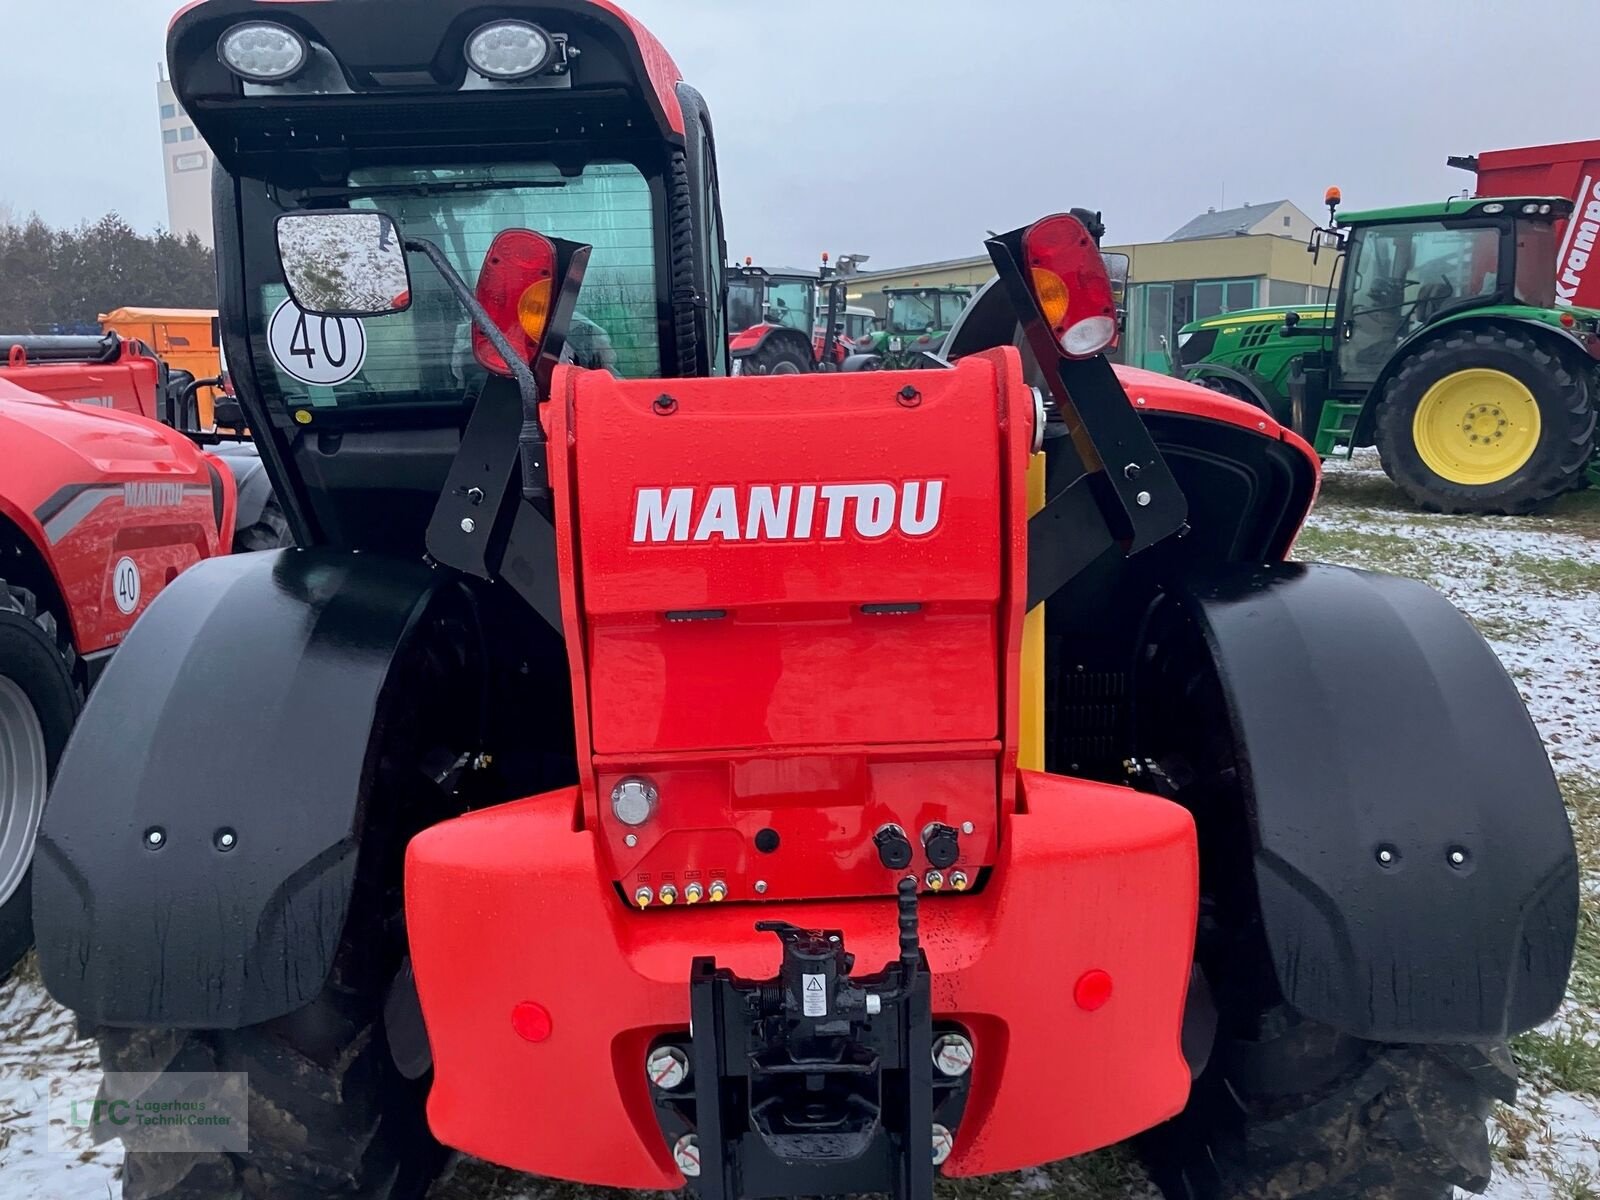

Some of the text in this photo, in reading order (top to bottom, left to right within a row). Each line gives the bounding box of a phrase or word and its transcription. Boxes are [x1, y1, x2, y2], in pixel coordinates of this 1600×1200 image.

[289, 313, 346, 369] 40
[125, 482, 183, 506] MANITOU
[633, 480, 943, 543] MANITOU
[120, 567, 135, 603] 40
